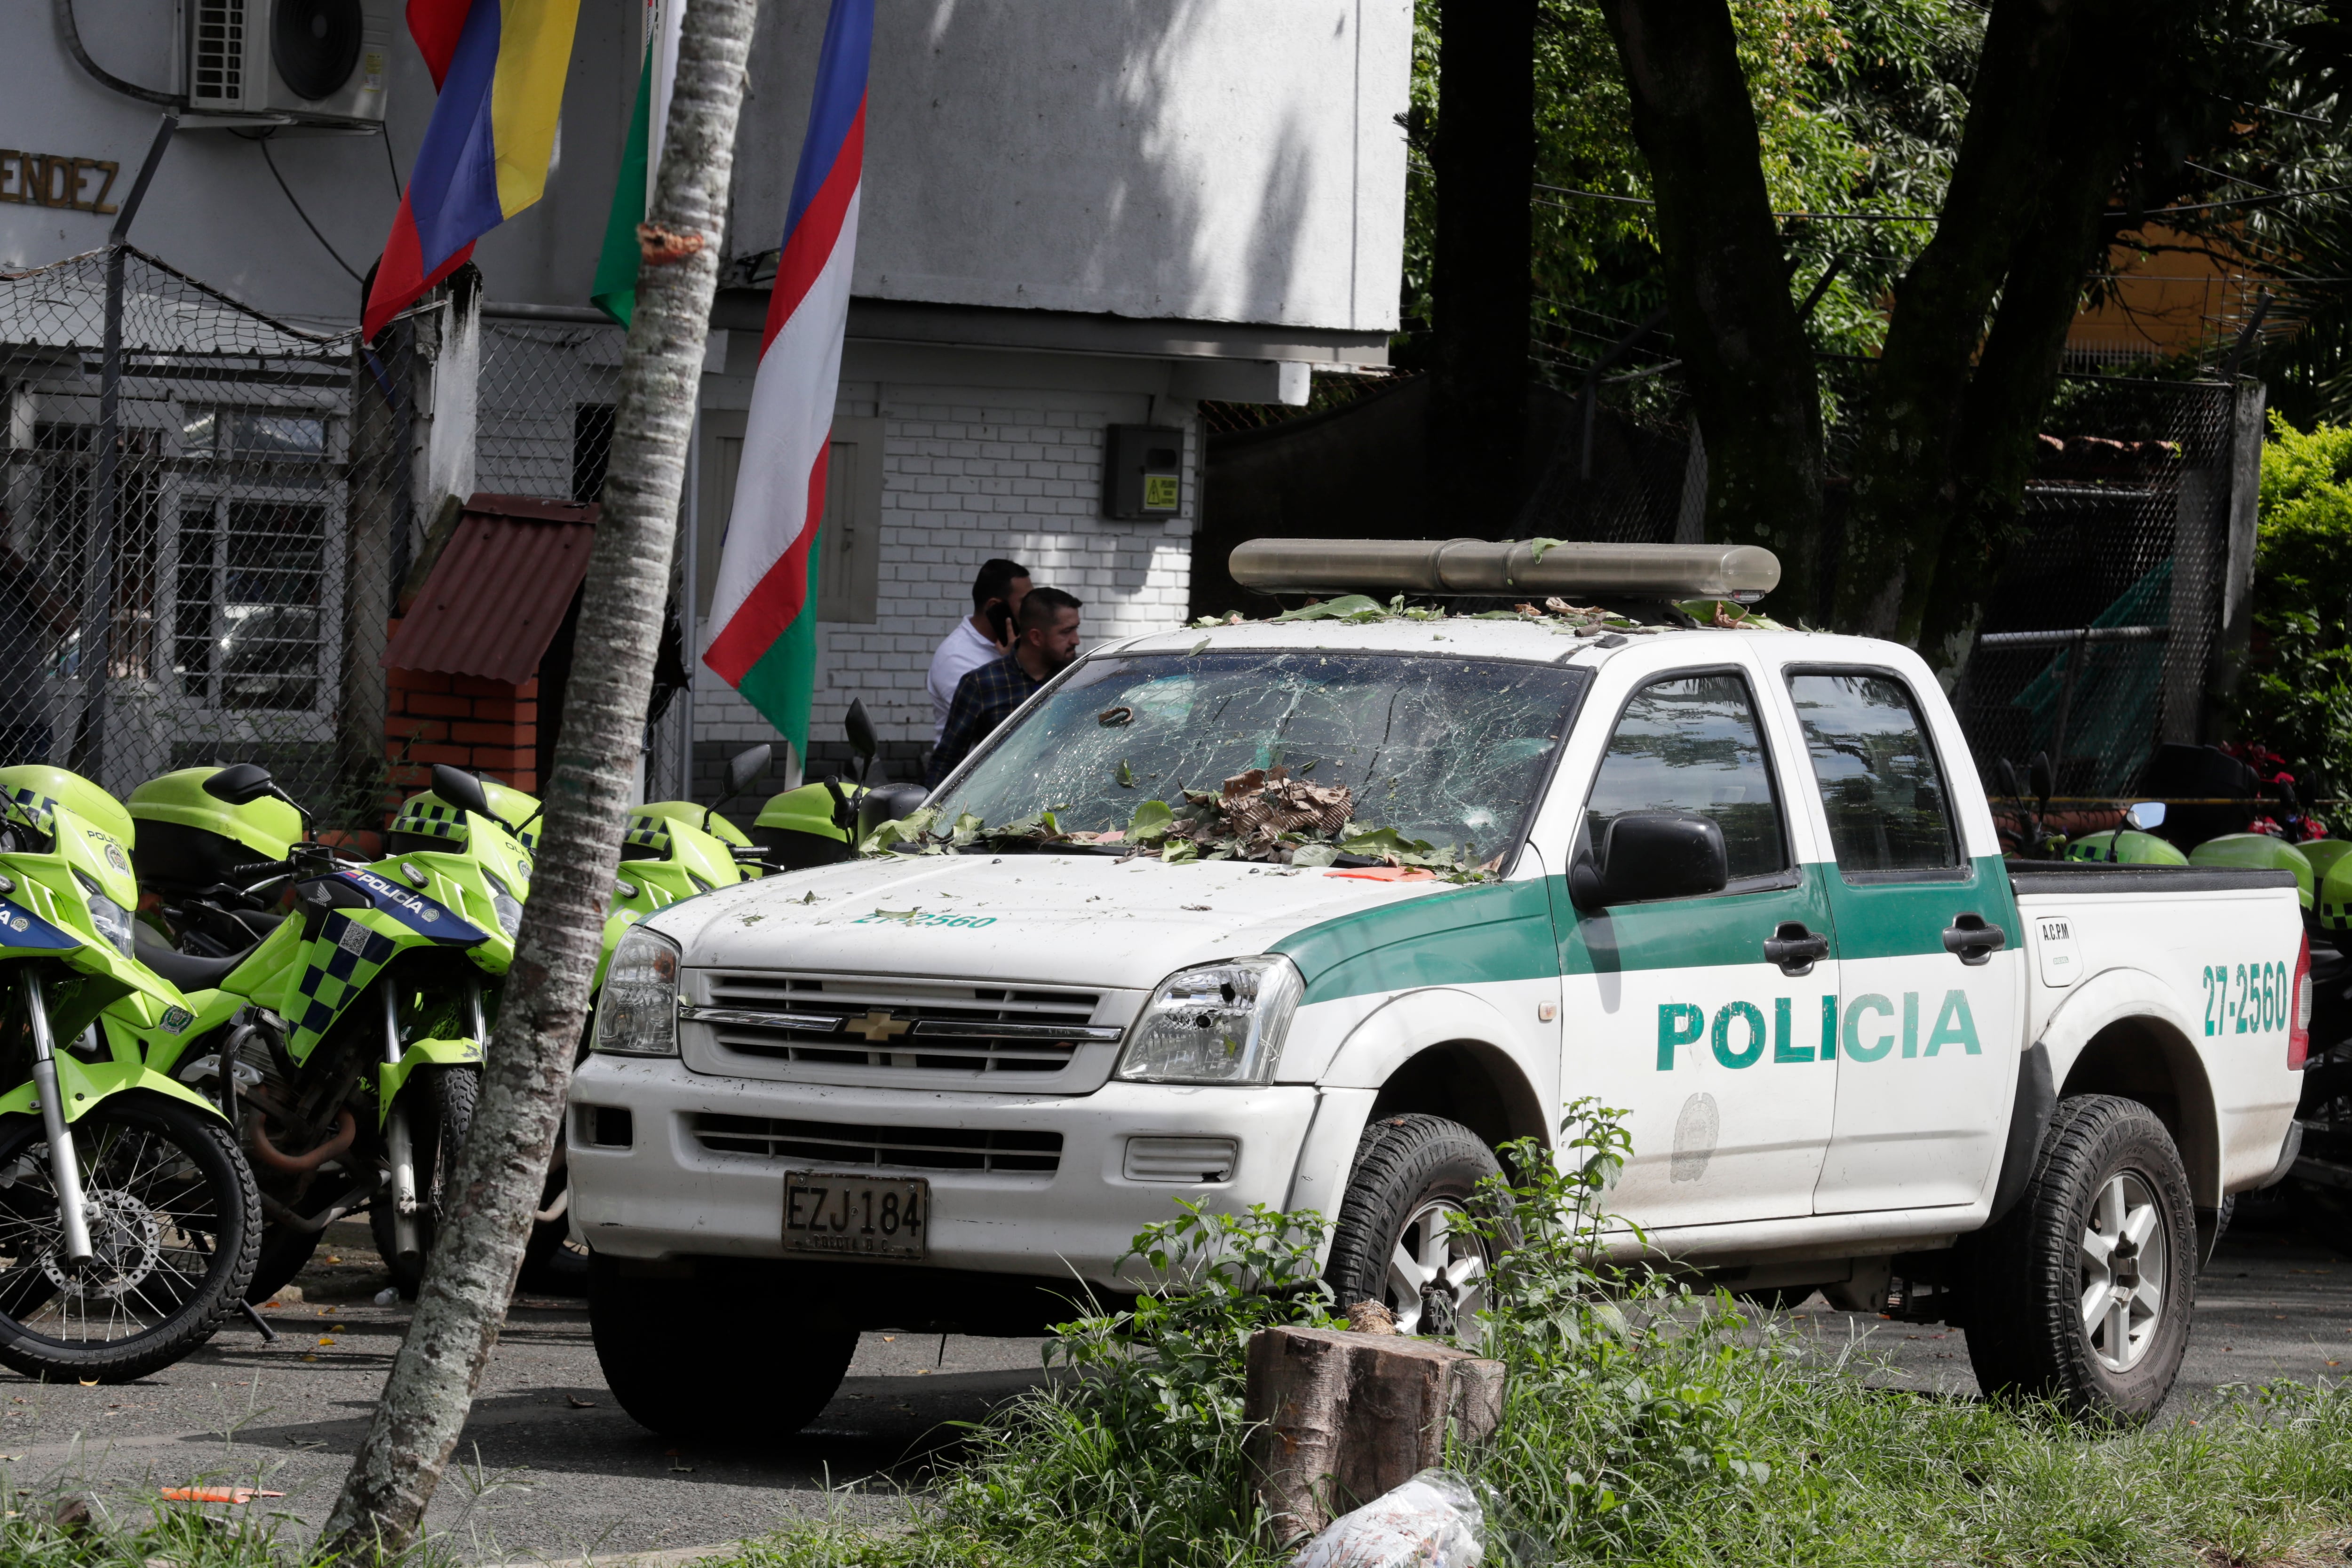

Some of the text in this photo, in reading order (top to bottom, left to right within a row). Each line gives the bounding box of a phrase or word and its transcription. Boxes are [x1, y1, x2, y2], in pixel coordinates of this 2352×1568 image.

[0, 149, 119, 214] ENDEZ
[307, 897, 327, 907] HONDA
[357, 874, 424, 914] POLICÍA
[1656, 989, 1982, 1071] POLICIA
[2203, 961, 2287, 1036] 27-2560
